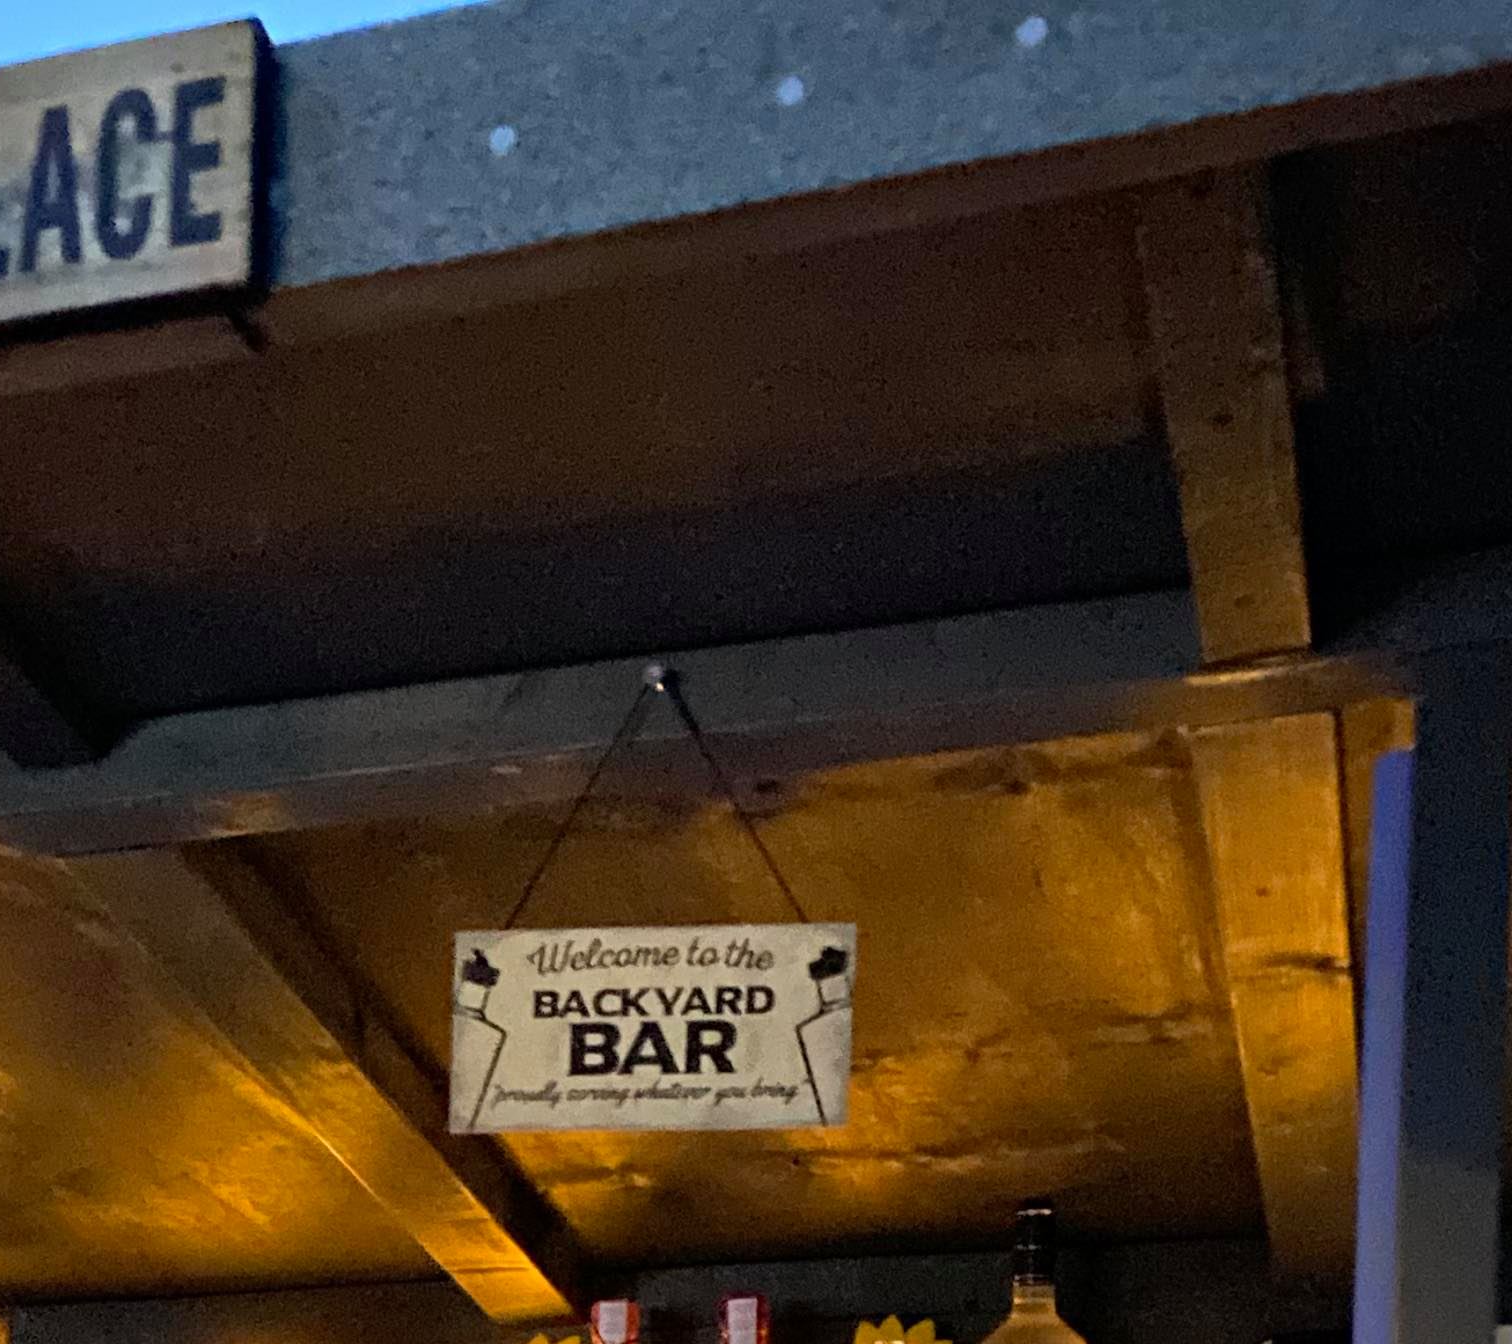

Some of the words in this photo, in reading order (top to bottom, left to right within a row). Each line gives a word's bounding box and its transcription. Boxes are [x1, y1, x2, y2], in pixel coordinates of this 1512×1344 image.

[526, 936, 680, 977] Welcome
[686, 938, 721, 967] to
[724, 937, 775, 971] the
[532, 985, 777, 1020] BACKYARD
[567, 1020, 738, 1077] BAR
